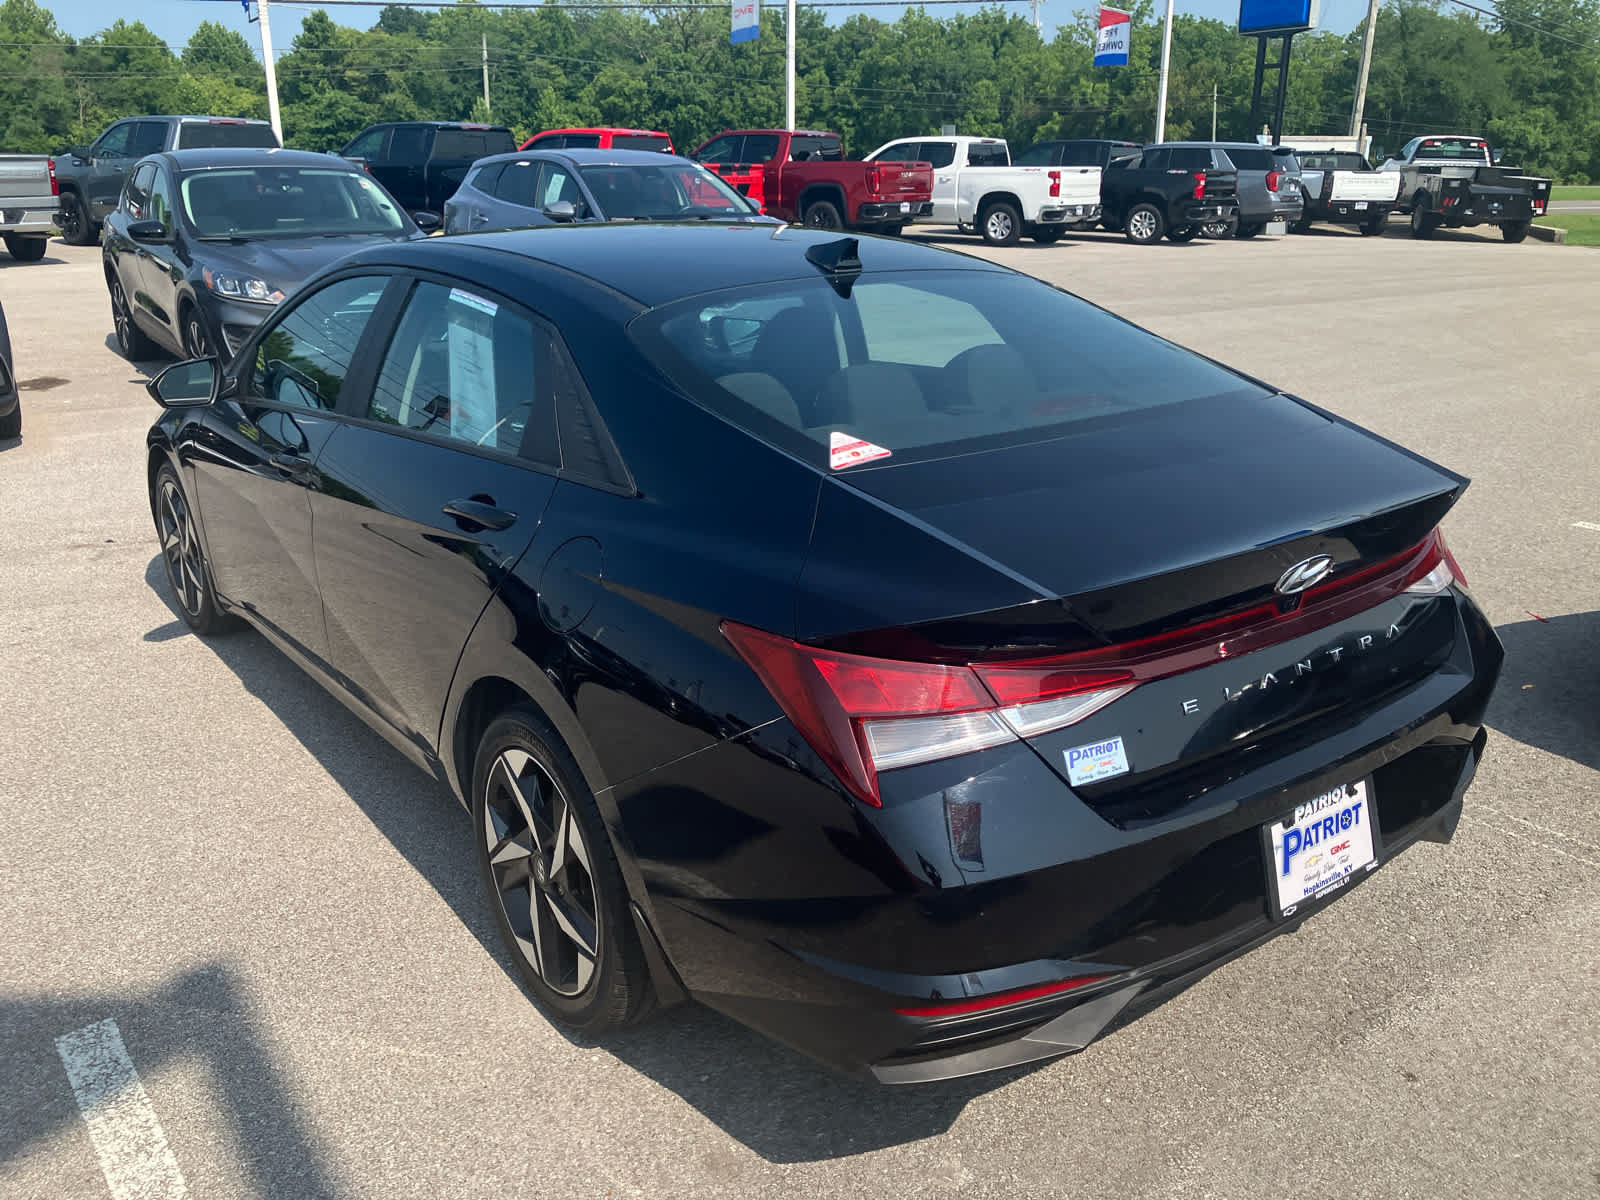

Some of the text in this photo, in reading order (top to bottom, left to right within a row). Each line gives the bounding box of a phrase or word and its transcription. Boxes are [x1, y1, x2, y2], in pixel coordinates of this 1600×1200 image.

[1180, 623, 1400, 716] ELANTRA
[1069, 740, 1120, 769] PATRIOT
[1295, 784, 1347, 823] PATRIOT
[1281, 802, 1362, 877] PATRIOT
[1330, 840, 1351, 855] GMC
[1303, 871, 1343, 896] Hopkinsville,
[1343, 863, 1354, 874] KY
